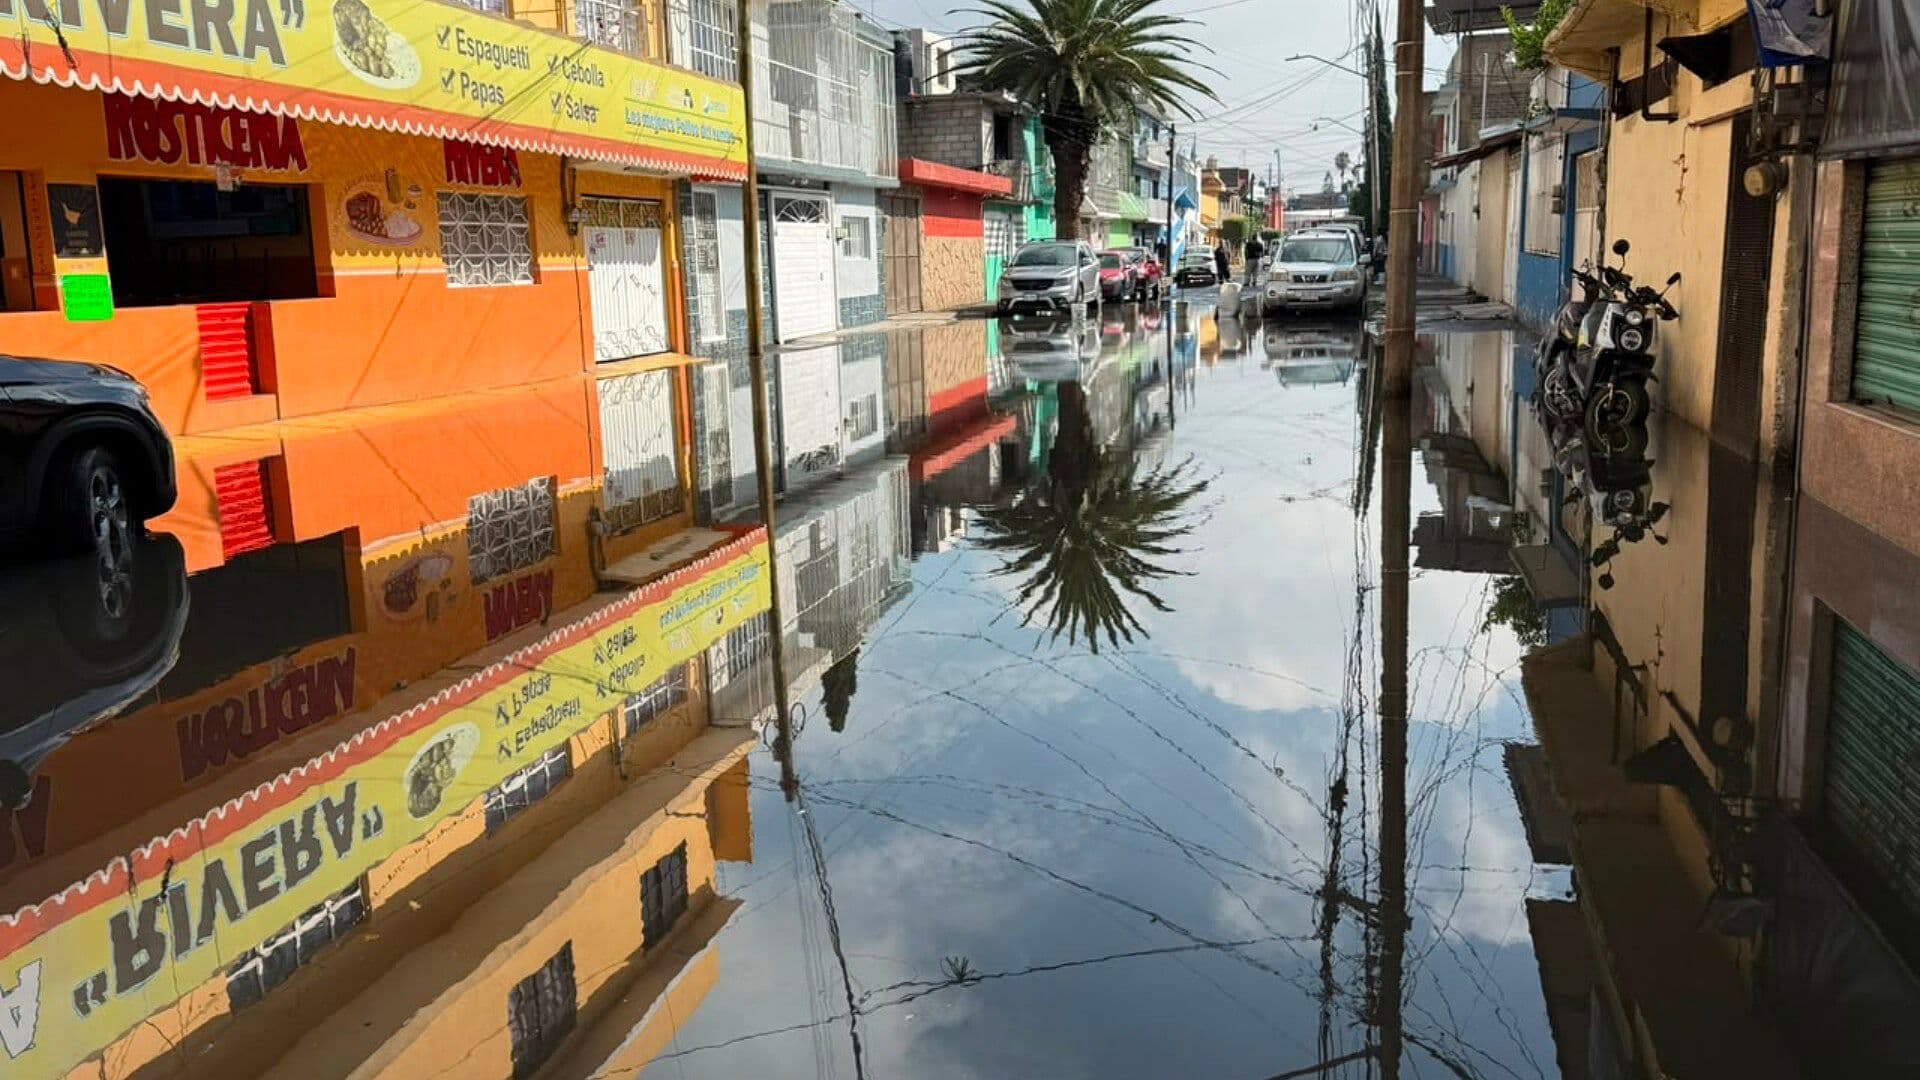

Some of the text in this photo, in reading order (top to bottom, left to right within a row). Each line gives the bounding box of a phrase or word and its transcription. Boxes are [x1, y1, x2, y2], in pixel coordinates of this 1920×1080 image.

[456, 28, 530, 70] Espaguetti
[460, 72, 504, 109] Papas
[562, 57, 604, 88] Cebolla
